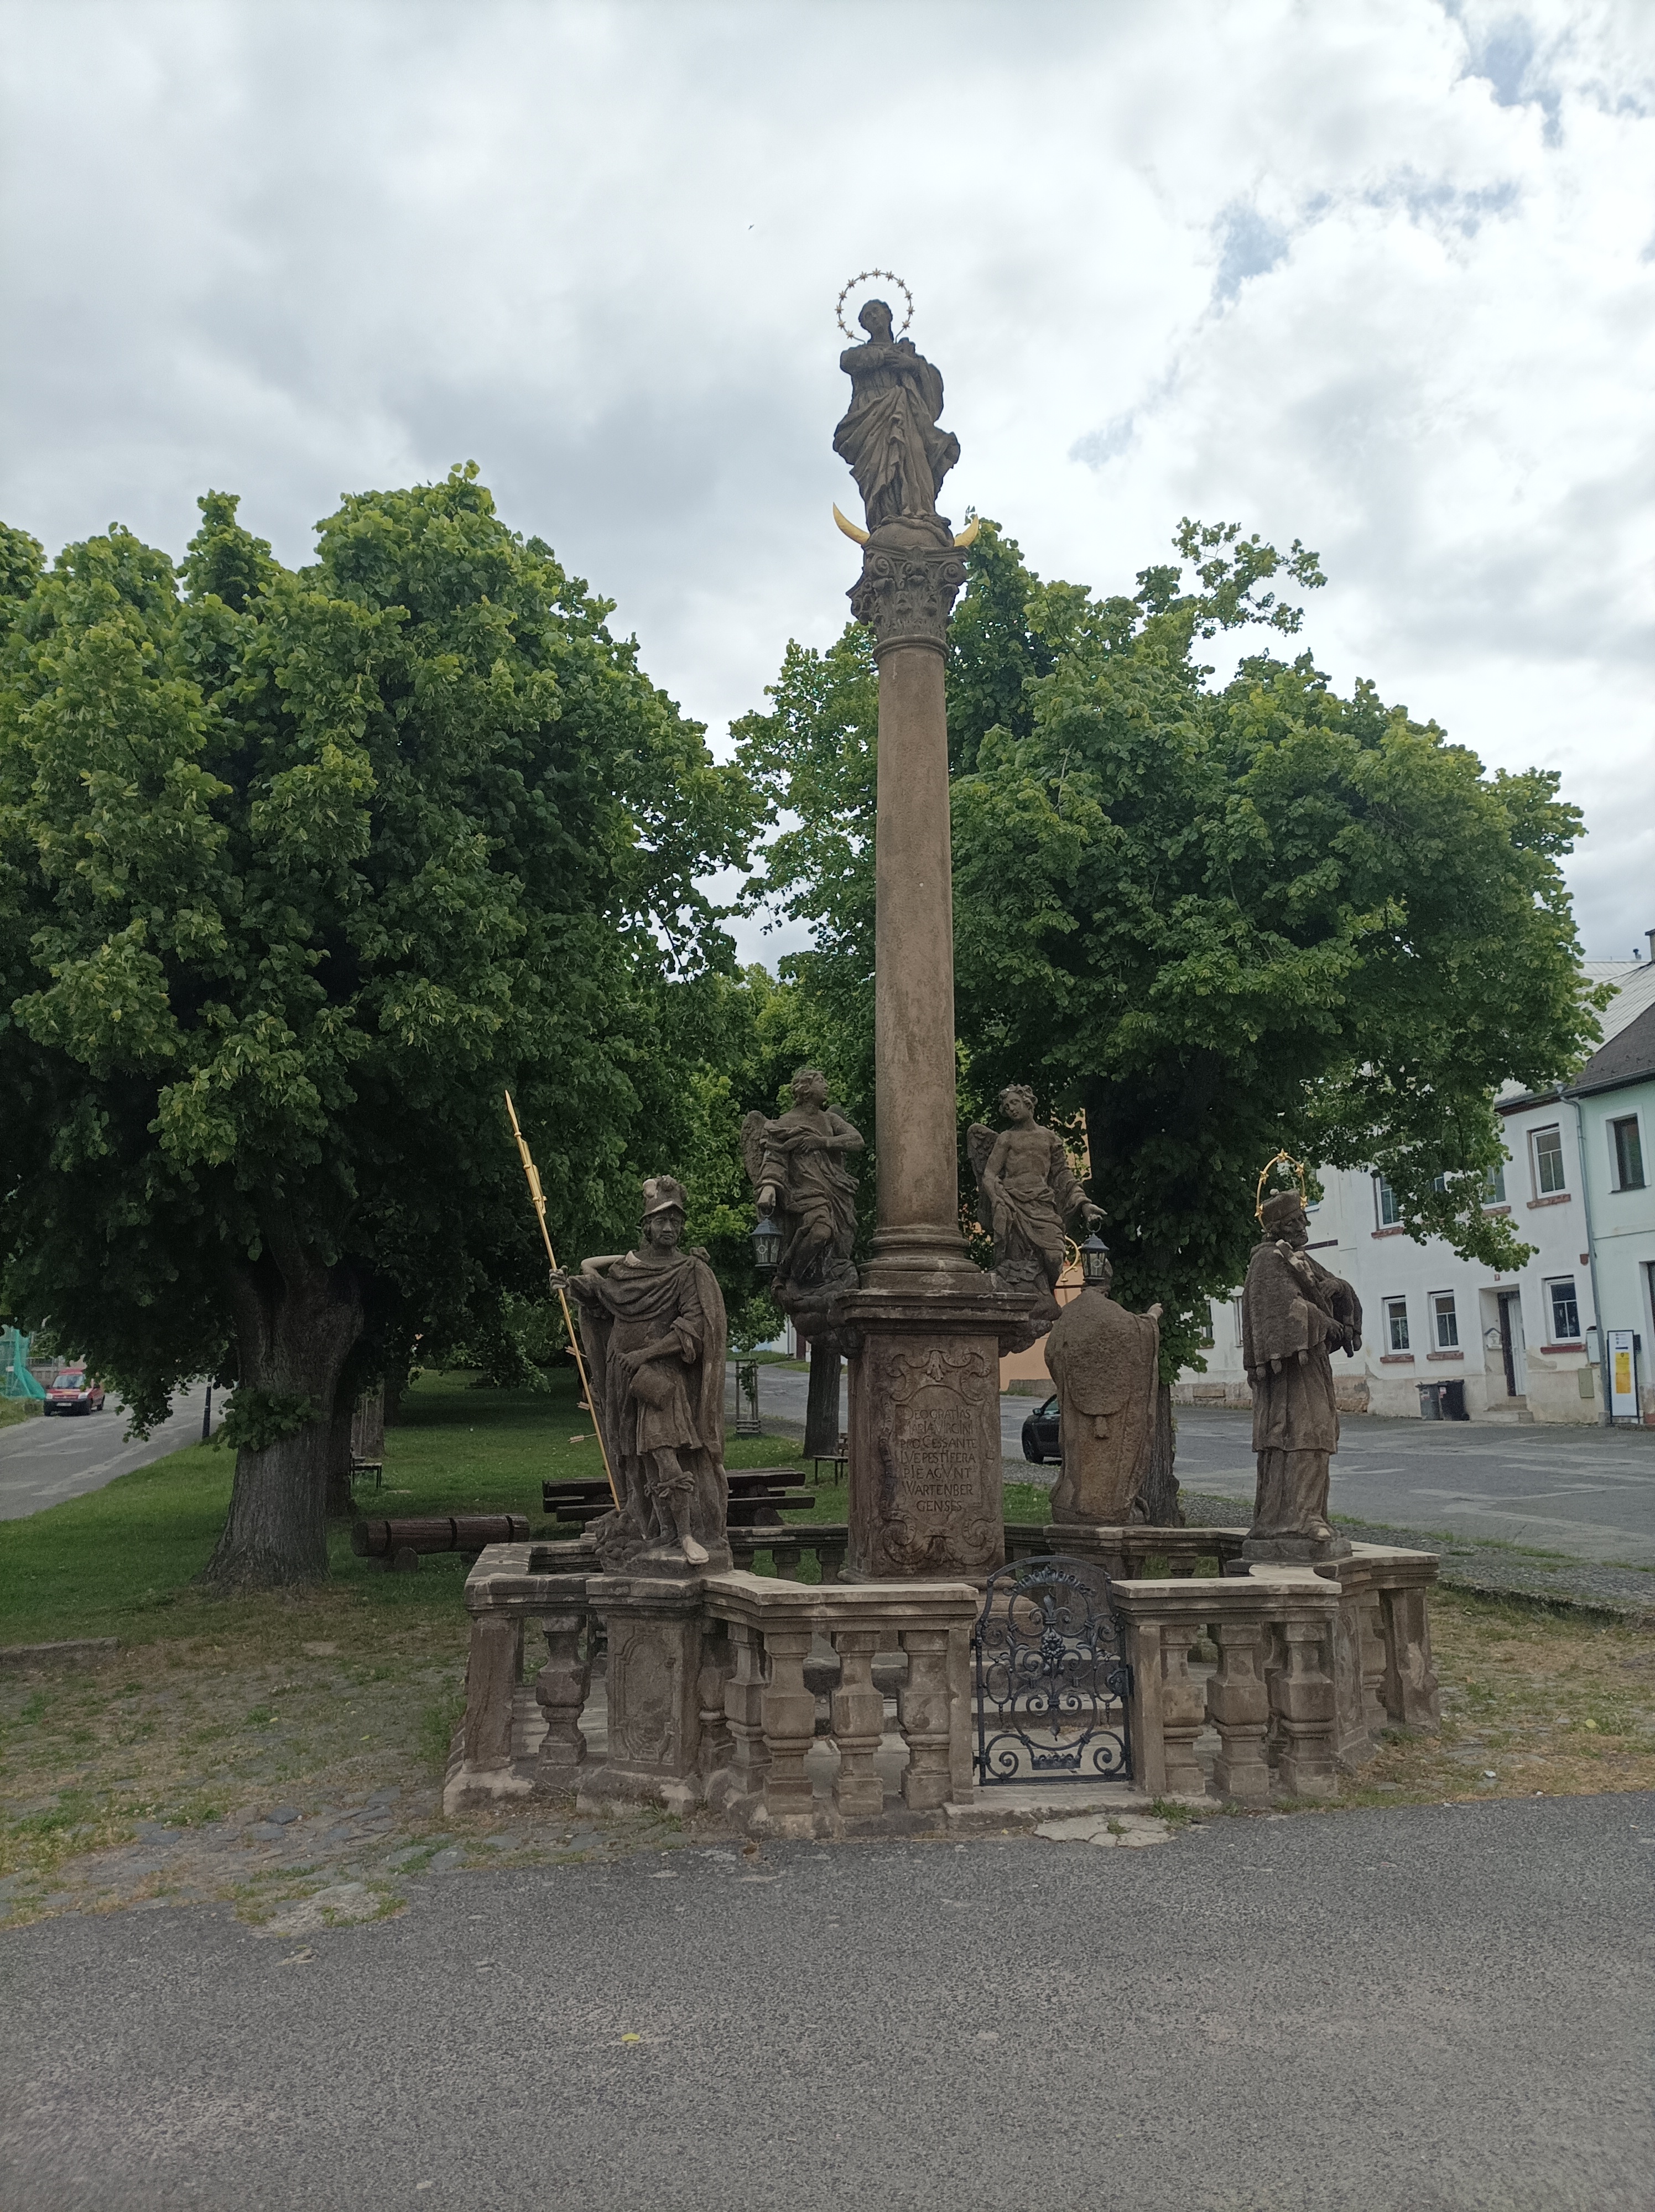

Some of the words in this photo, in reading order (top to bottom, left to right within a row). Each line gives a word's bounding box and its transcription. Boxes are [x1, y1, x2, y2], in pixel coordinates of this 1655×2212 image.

[929, 1405, 971, 1420] GRATIAS
[923, 1435, 977, 1448] CESSANTE
[901, 1451, 920, 1465] LVE
[922, 1450, 976, 1464] PESTIFERA
[904, 1464, 924, 1479] PIE
[925, 1464, 972, 1479] AGVNT
[902, 1481, 974, 1496] WARTENBER
[916, 1500, 962, 1512] GENSES
